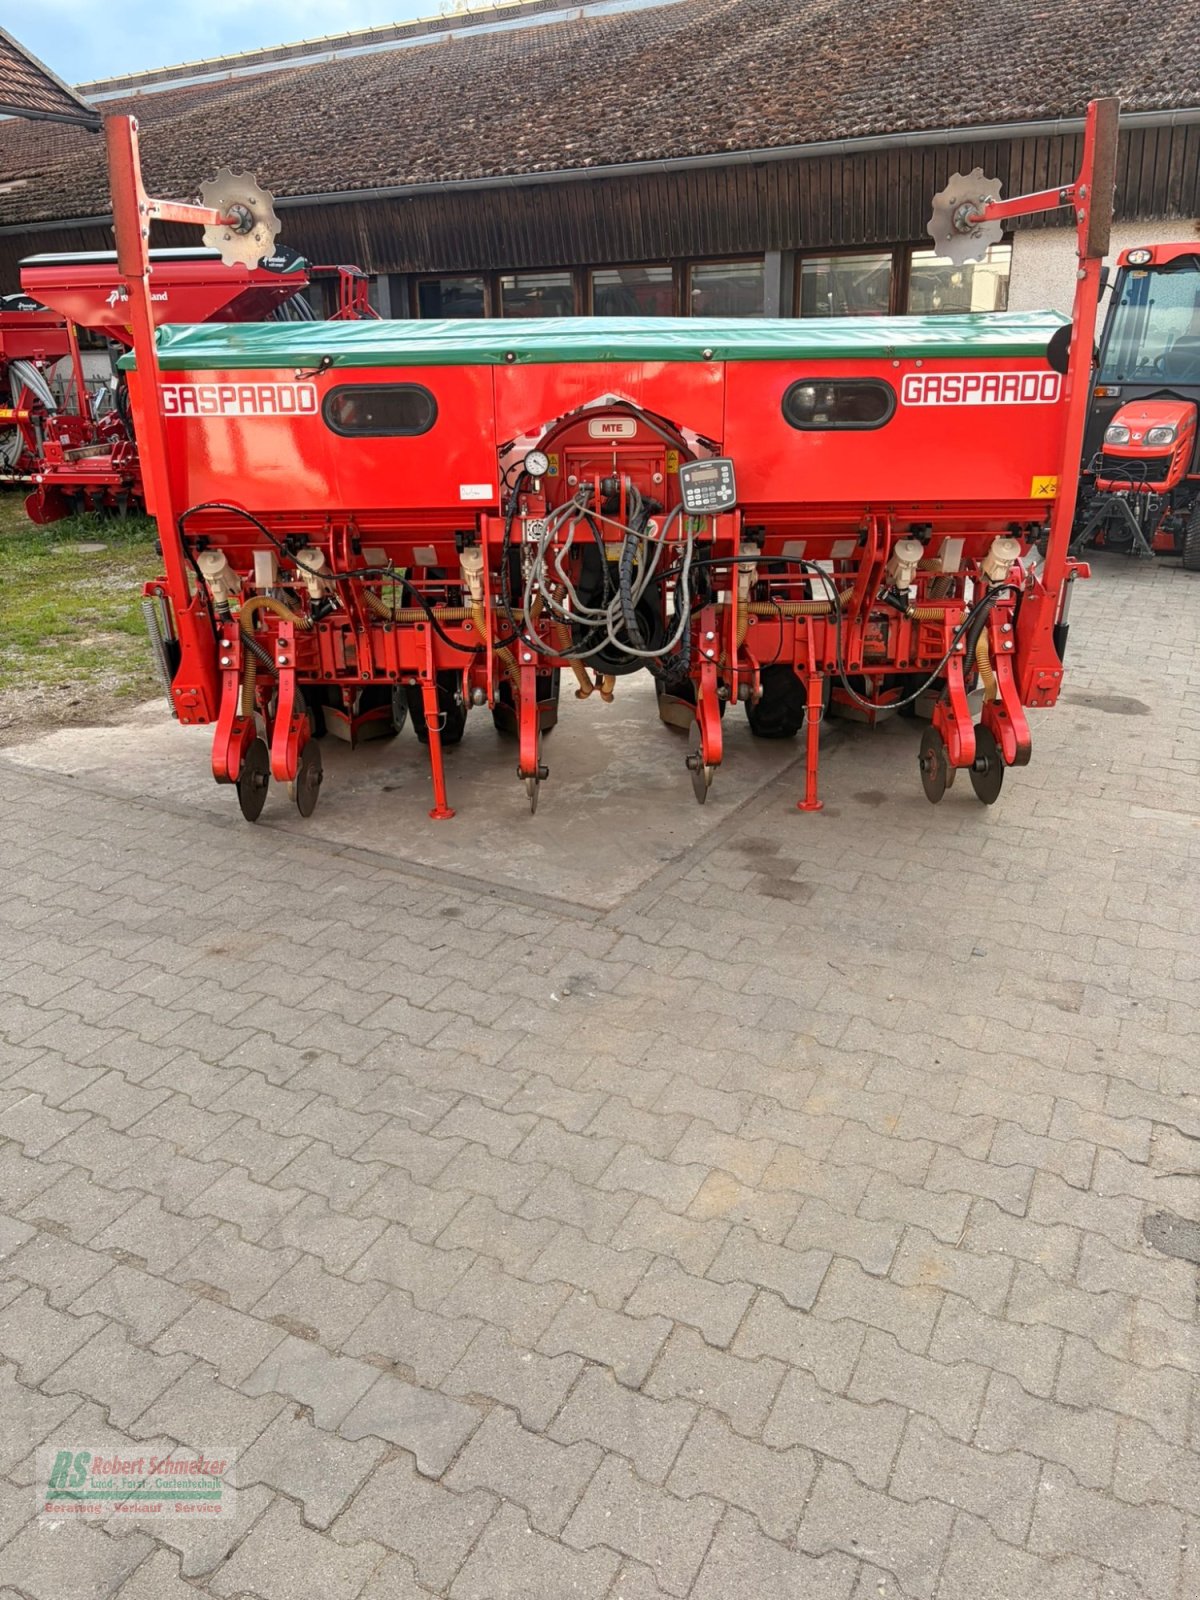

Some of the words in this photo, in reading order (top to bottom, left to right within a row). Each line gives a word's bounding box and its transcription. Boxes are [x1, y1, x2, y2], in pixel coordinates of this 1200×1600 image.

[162, 386, 315, 413] GASPARDO
[904, 374, 1060, 402] GASPARDO
[602, 424, 623, 432] MTE
